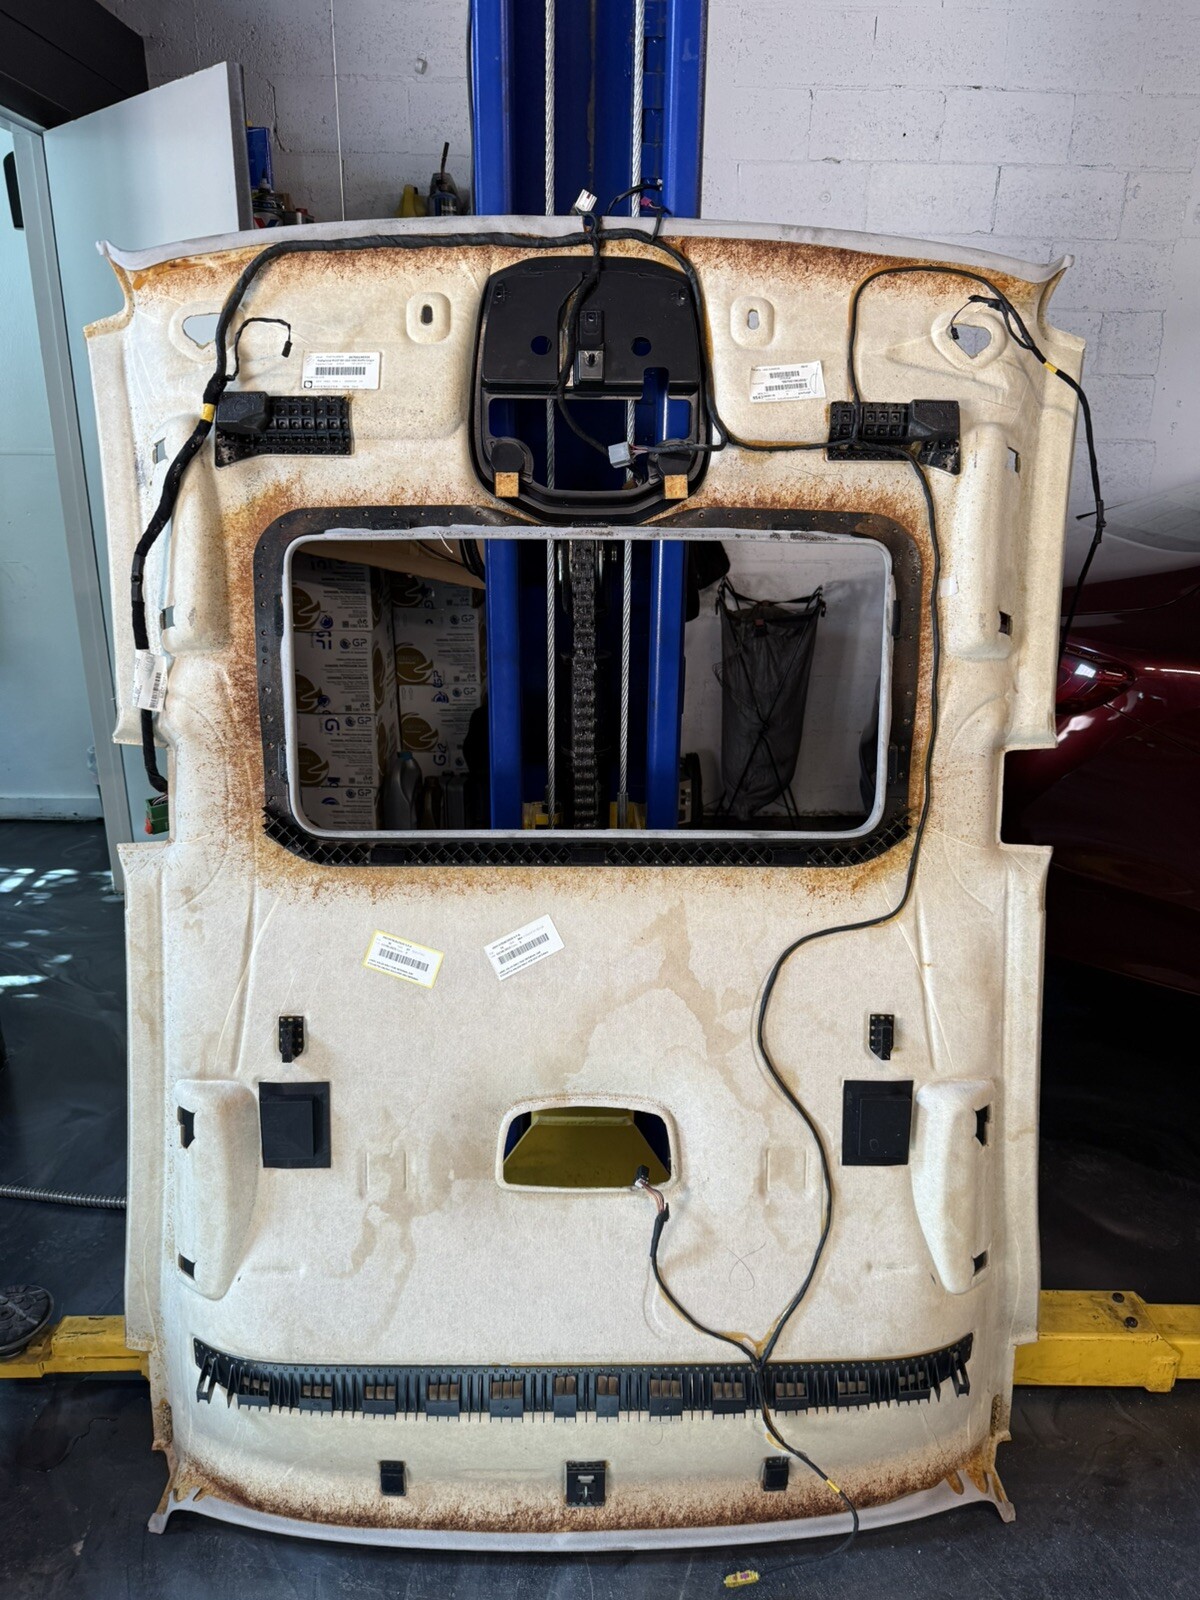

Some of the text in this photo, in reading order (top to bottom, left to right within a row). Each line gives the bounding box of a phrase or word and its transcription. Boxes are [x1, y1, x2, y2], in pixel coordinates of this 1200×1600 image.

[352, 638, 367, 647] GP
[463, 687, 476, 696] GP
[357, 716, 372, 725] GP
[357, 788, 372, 797] GP
